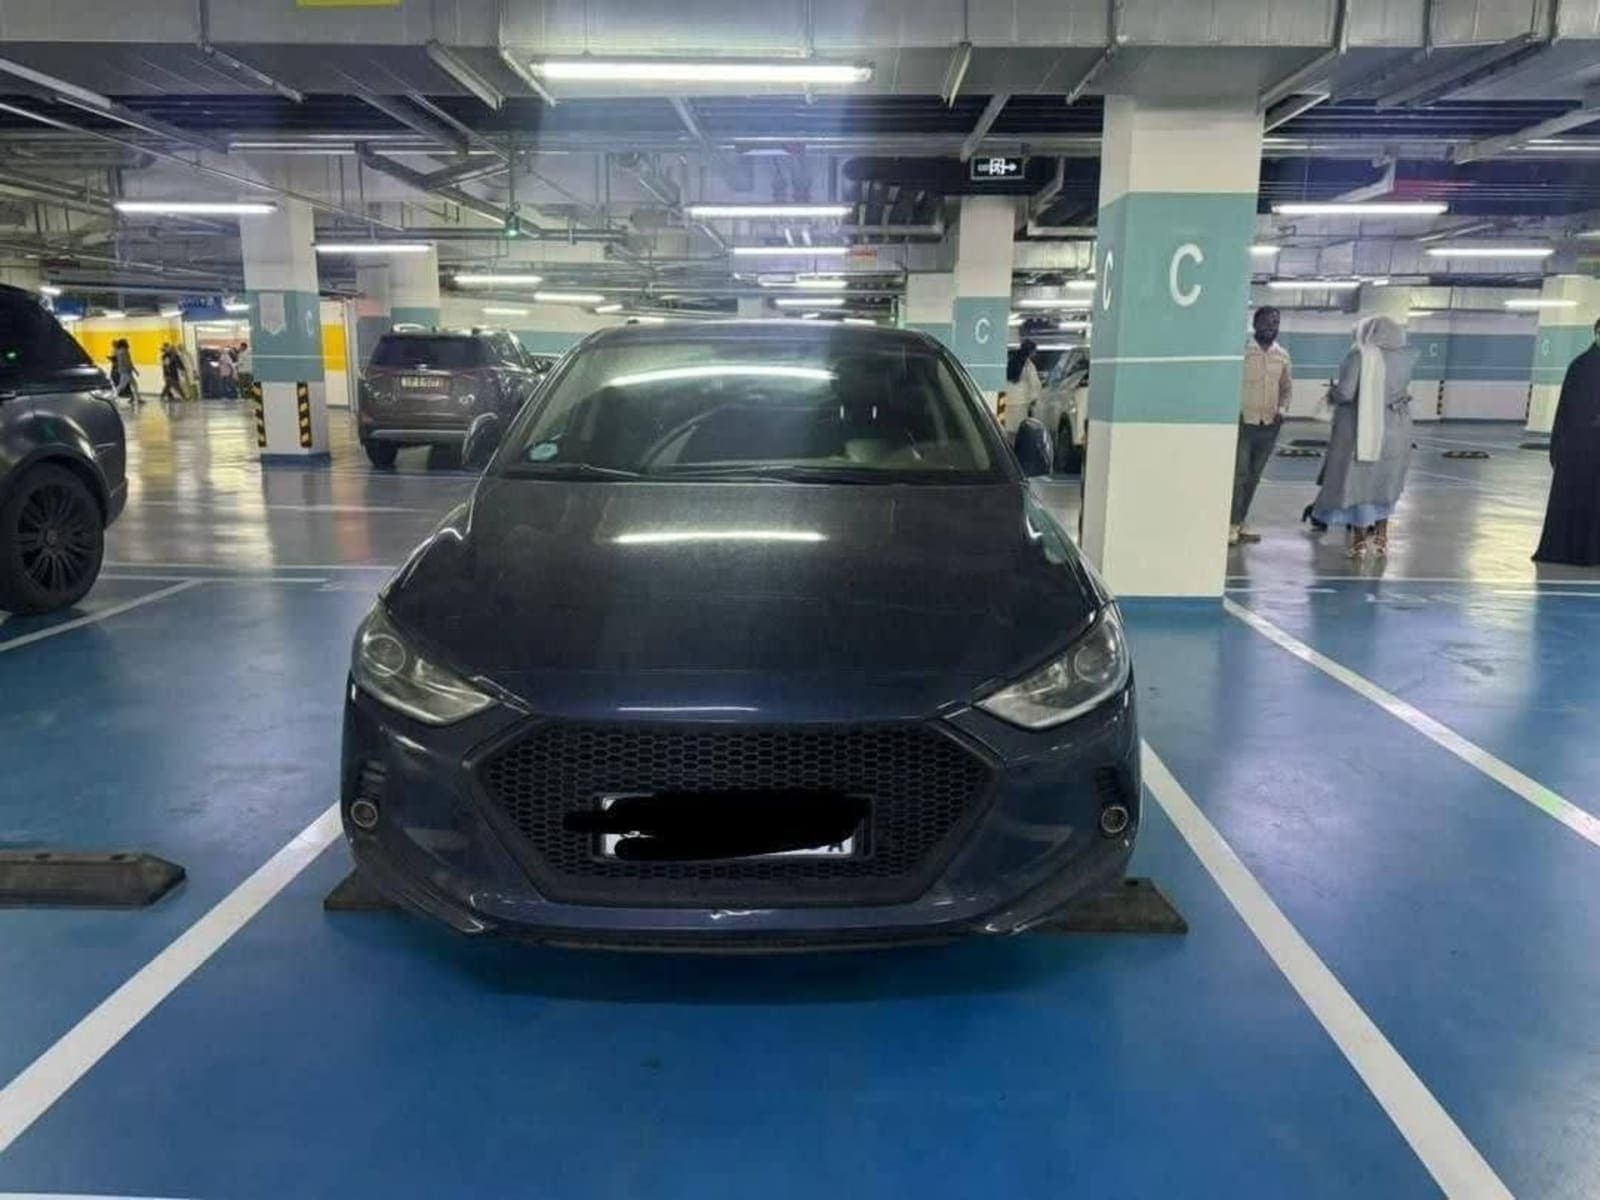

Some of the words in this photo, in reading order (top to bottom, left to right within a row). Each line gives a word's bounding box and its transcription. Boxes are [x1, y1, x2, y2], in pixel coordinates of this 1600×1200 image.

[1102, 250, 1113, 311] C
[1169, 243, 1204, 307] C
[974, 317, 991, 345] C
